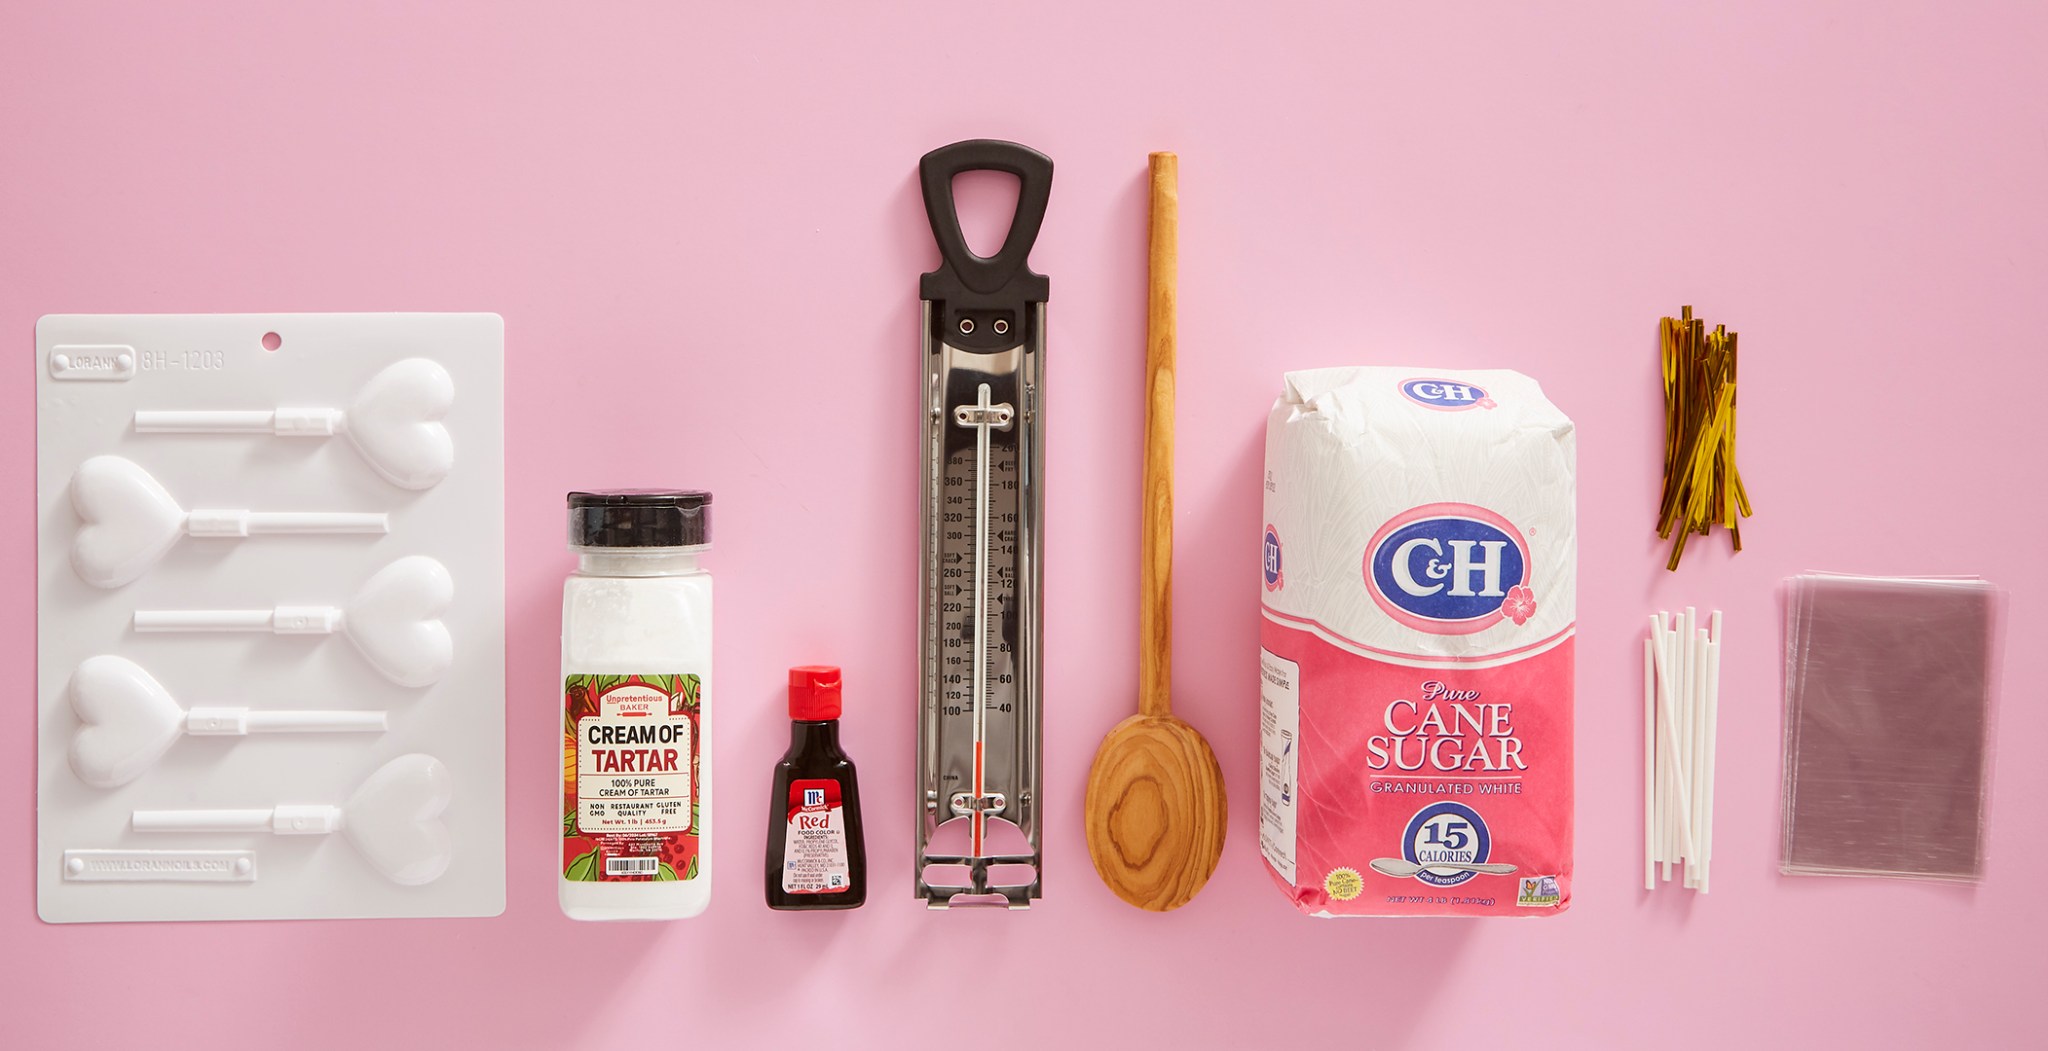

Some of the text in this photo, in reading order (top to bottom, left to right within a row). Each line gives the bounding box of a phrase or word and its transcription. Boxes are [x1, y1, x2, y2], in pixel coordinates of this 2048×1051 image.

[1412, 383, 1477, 401] C&H
[944, 476, 963, 487] 360
[1001, 480, 1018, 490] 180
[947, 496, 963, 504] 340
[944, 512, 963, 522] 320
[947, 531, 962, 540] 300
[1391, 538, 1508, 597] C&H
[943, 568, 962, 578] 260
[943, 602, 962, 612] 220
[946, 622, 961, 631] 200
[943, 638, 961, 648] 180
[1000, 643, 1012, 653] 80
[946, 656, 961, 665] 160
[943, 674, 961, 684] 140
[999, 674, 1012, 684] 60
[945, 691, 961, 699] 120
[1421, 680, 1481, 701] Pure
[606, 694, 663, 704] Unpretentious
[942, 706, 961, 716] 100
[999, 703, 1012, 713] 40
[1383, 699, 1515, 738] CANE
[588, 724, 684, 745] CREAM OF
[1366, 735, 1529, 772] SUGAR
[591, 748, 679, 773] TARTAR
[611, 778, 656, 788] 100% PURE
[1370, 780, 1523, 795] GRANULATED WHITE
[599, 788, 670, 797] CREAM OF TARTAR
[799, 814, 830, 830] Red
[1423, 822, 1469, 850] 15
[1419, 850, 1472, 862] CALORIES
[1420, 871, 1470, 885] per teaspoon
